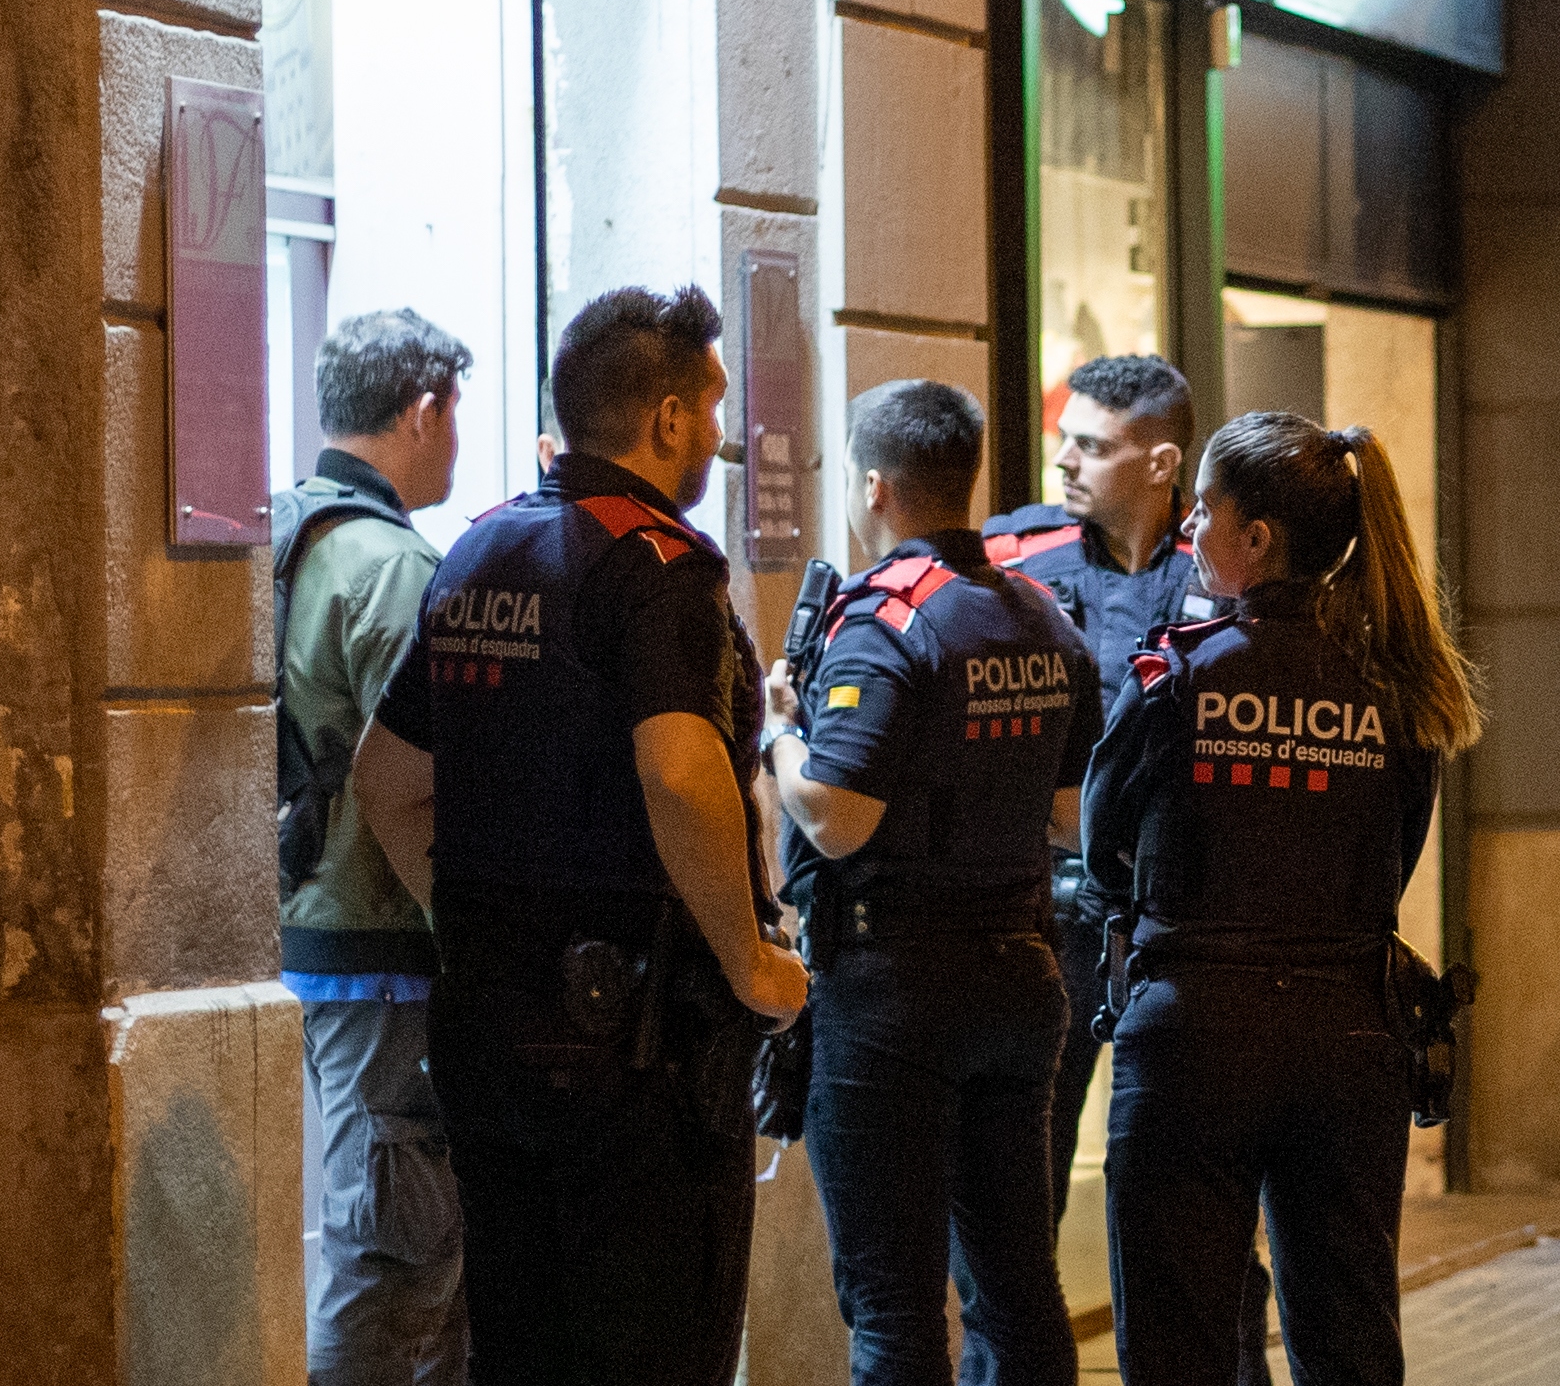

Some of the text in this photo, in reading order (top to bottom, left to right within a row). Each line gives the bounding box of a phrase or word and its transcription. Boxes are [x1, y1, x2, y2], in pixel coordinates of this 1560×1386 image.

[966, 652, 1070, 694] POLICIA
[967, 698, 1013, 715] mossos
[1196, 691, 1387, 746] POLICIA
[1195, 738, 1386, 770] mossos d'esquadra
